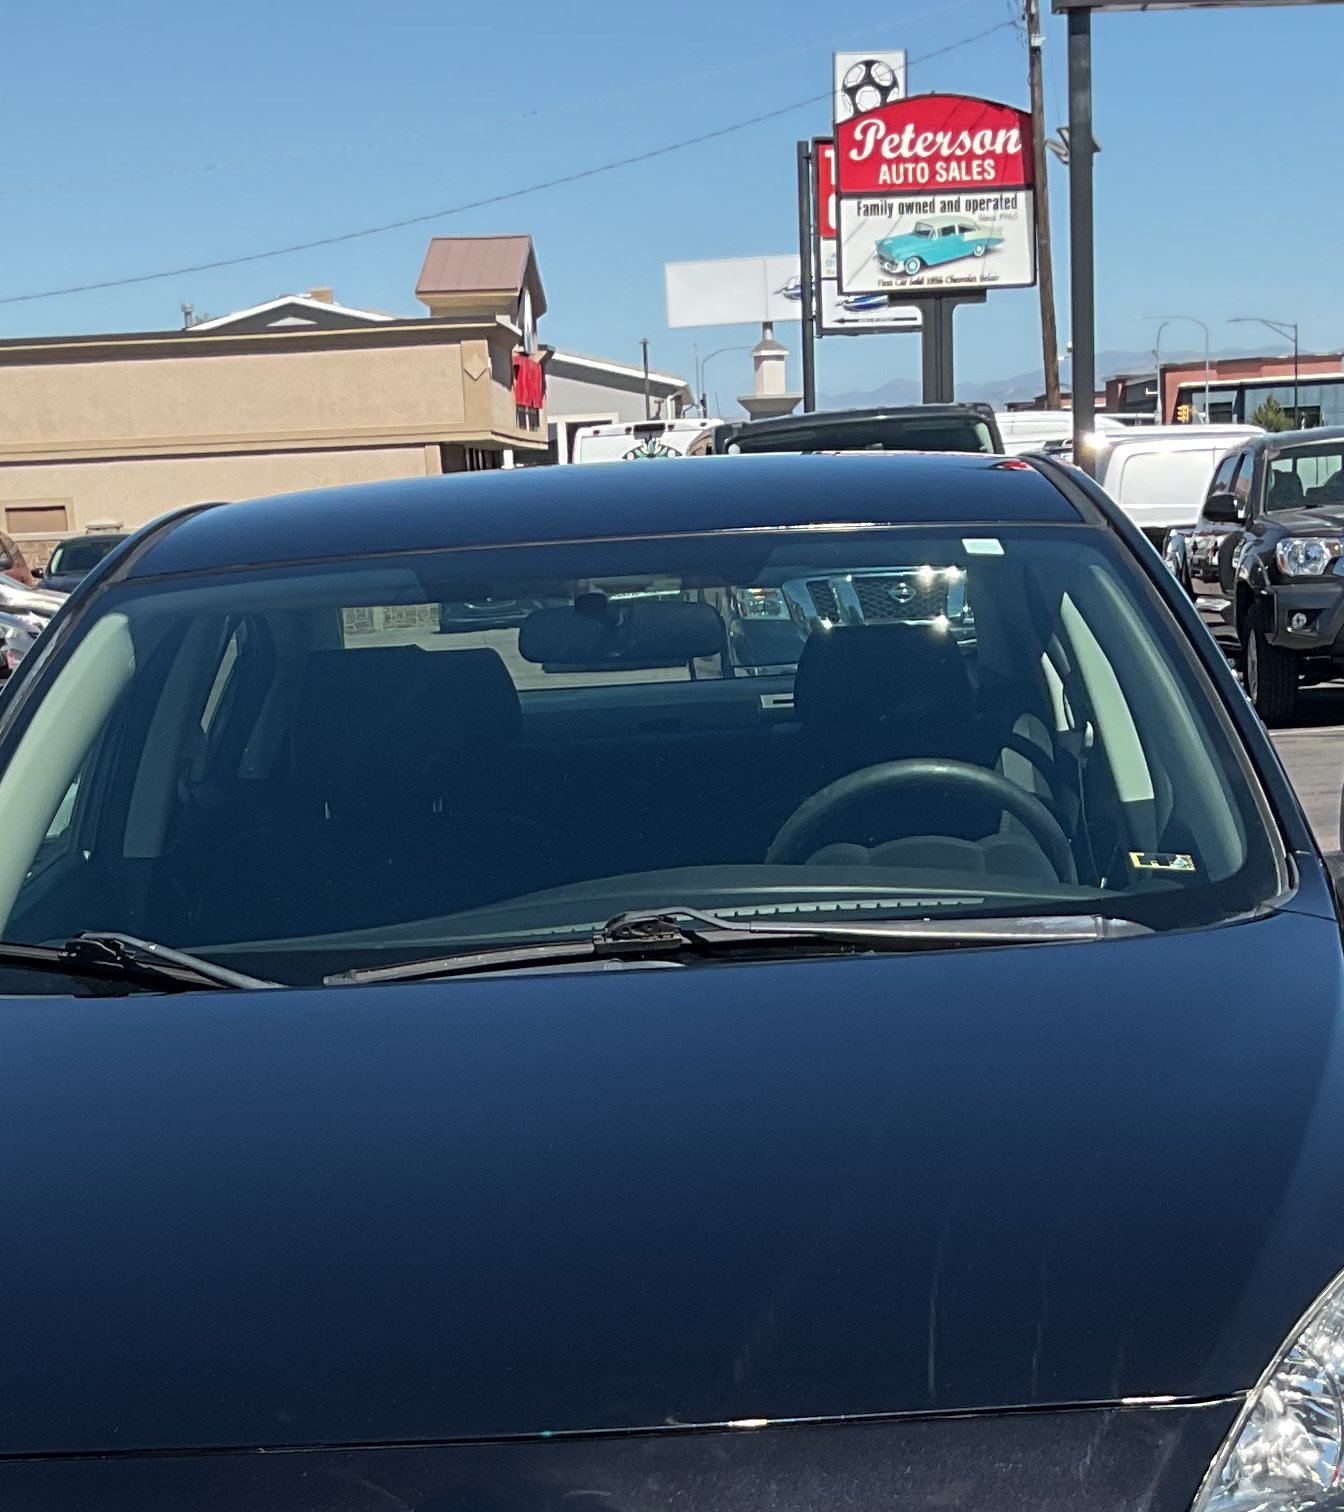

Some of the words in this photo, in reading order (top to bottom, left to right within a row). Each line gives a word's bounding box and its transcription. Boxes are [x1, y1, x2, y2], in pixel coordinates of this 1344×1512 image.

[849, 118, 1022, 161] Peterson
[878, 162, 929, 185] AUTO
[935, 159, 995, 182] SALES
[857, 200, 894, 219] Family
[898, 197, 936, 215] owned
[940, 196, 960, 213] and
[965, 194, 1018, 214] operated
